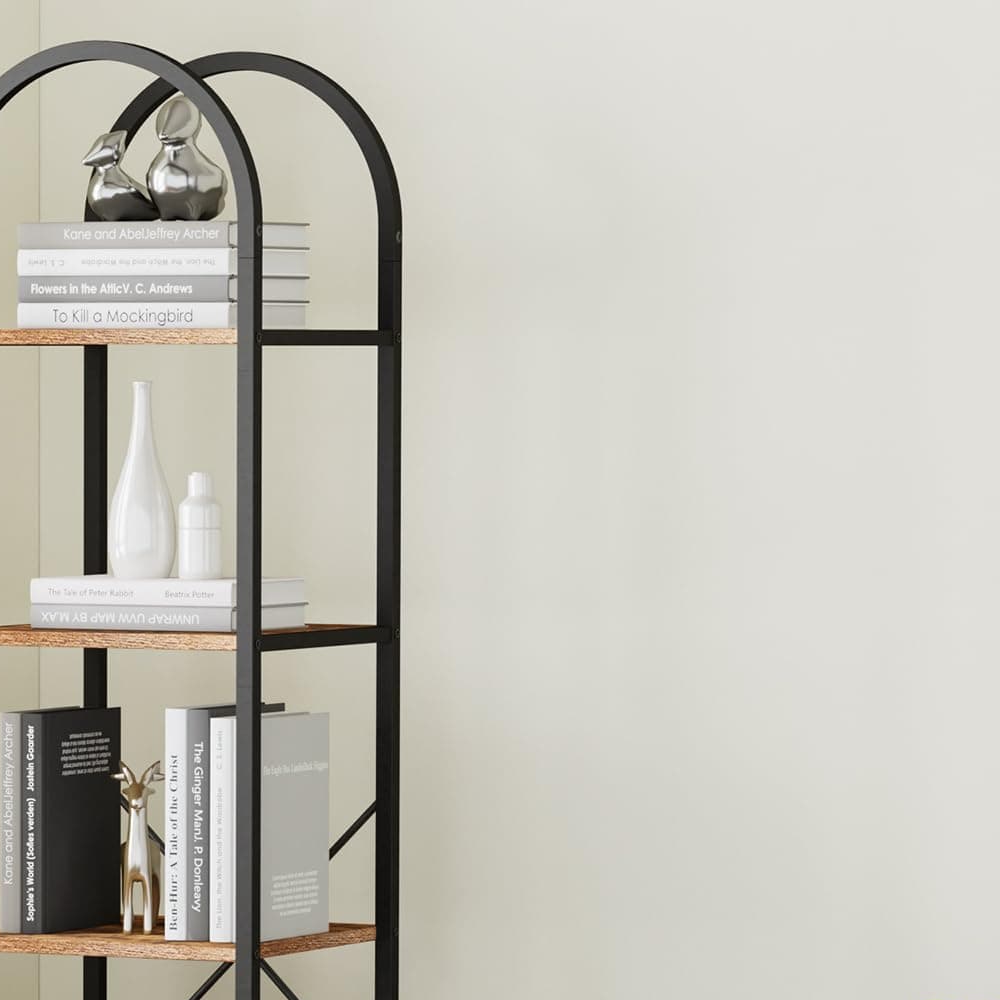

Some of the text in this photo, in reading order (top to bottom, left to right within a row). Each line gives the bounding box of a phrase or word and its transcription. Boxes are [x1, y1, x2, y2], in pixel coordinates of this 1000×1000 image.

[63, 227, 90, 240] Kane
[95, 227, 116, 240] and
[183, 227, 219, 240] Archer
[30, 283, 67, 295] Flowers
[69, 283, 78, 295] in
[80, 283, 97, 295] the
[135, 283, 146, 295] C.
[149, 283, 193, 295] Andrews
[52, 309, 193, 326] To Kill a Mockingbird
[192, 590, 215, 599] Potter
[72, 612, 88, 623] BY
[91, 612, 115, 624] MAP
[116, 613, 146, 624] UVW
[148, 614, 200, 625] UNWRAP
[3, 722, 15, 760] Archer
[26, 725, 36, 792] Jostein Gaarder
[194, 741, 204, 764] The
[169, 754, 178, 793] Christ
[191, 766, 204, 806] Ginger
[26, 797, 37, 829] verden)
[169, 796, 178, 815] the
[169, 817, 178, 828] of
[3, 829, 15, 852] and
[169, 832, 178, 857] Tale
[194, 846, 204, 856] P.
[3, 853, 15, 885] Kane
[26, 861, 35, 885] World
[169, 861, 178, 869] A
[191, 857, 204, 913] Donleavy
[26, 885, 36, 922] Sophie's
